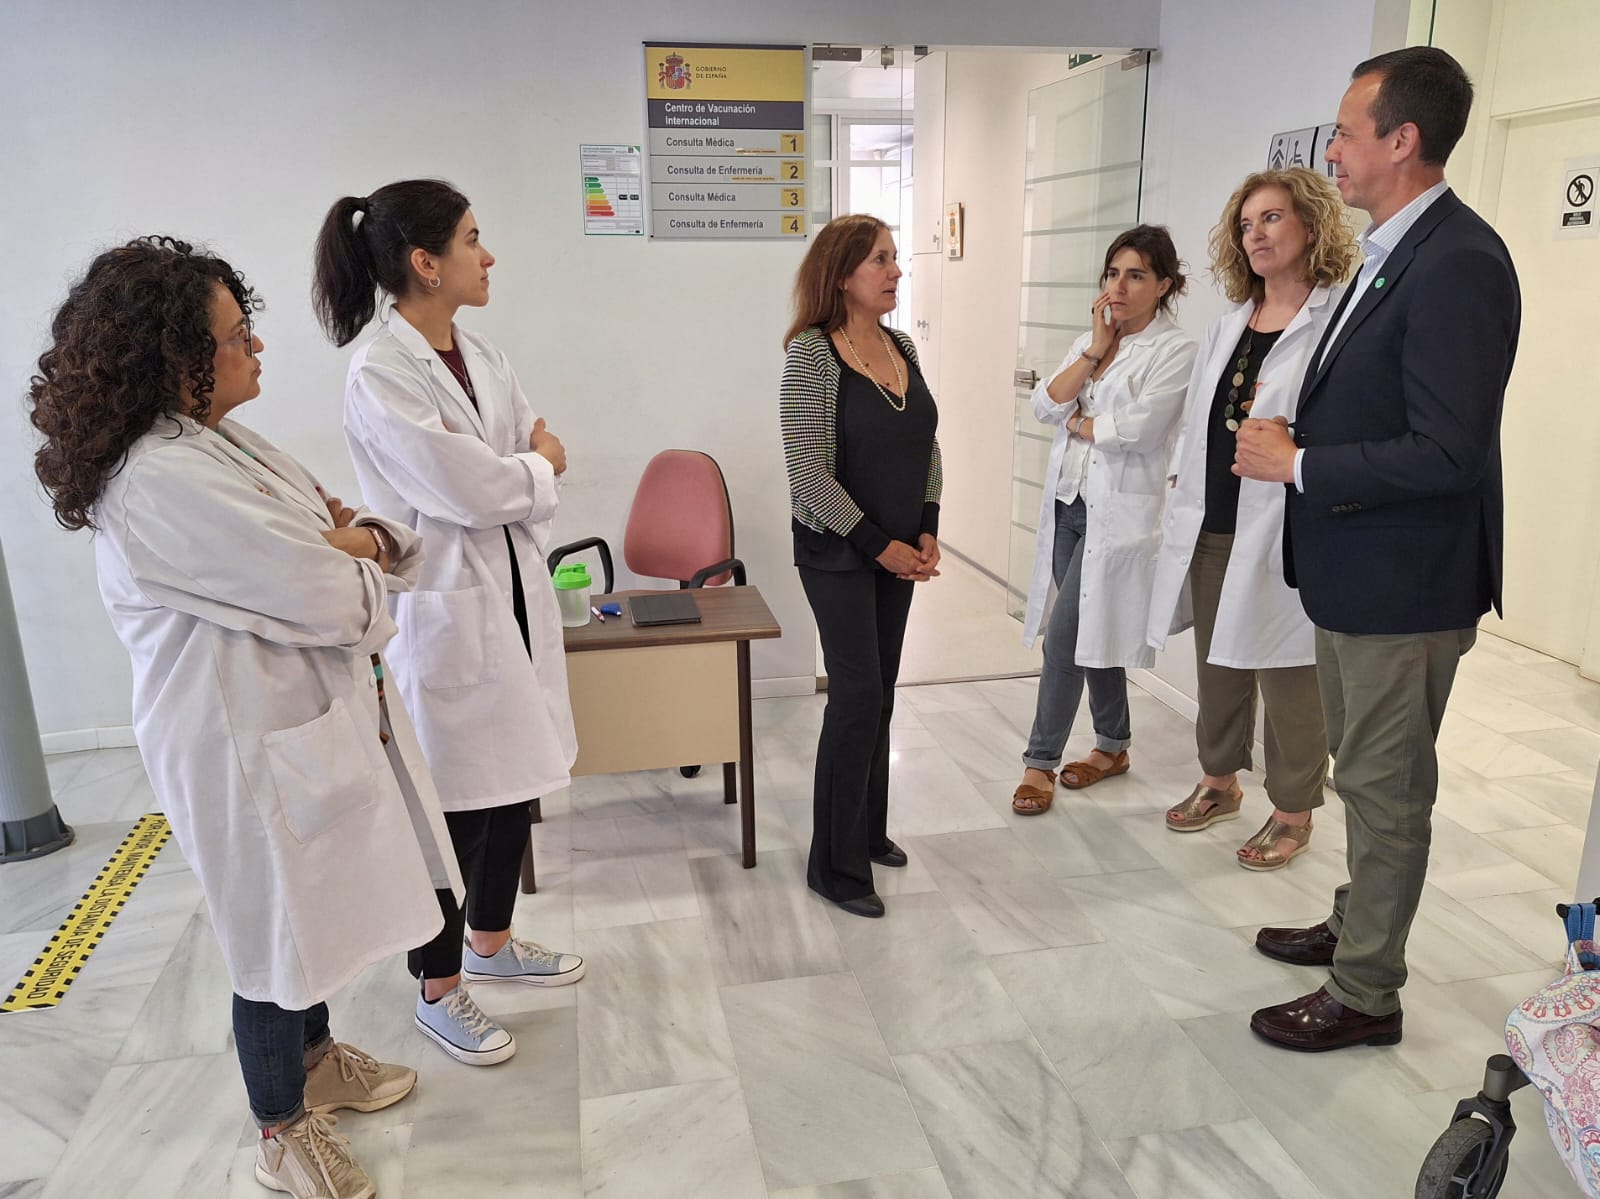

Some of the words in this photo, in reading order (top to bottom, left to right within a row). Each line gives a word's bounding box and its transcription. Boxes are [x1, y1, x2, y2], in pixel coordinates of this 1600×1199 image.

[664, 103, 694, 113] Centro
[695, 104, 706, 113] de
[708, 104, 756, 114] Vacunación
[665, 116, 720, 126] Internacional
[666, 137, 704, 147] Consulta
[706, 138, 735, 147] Médica
[790, 138, 796, 152] 1
[667, 166, 704, 175] Consulta
[706, 166, 716, 175] de
[718, 165, 762, 175] Enfermería
[790, 165, 798, 179] 2
[668, 192, 705, 202] Consulta
[707, 192, 736, 202] Médica
[790, 192, 798, 206] 3
[670, 219, 706, 229] Consulta
[708, 220, 718, 229] de
[720, 219, 764, 229] Enfermería
[790, 219, 799, 232] 4
[105, 852, 144, 888] MANTENGA
[100, 888, 120, 898] LA
[72, 898, 110, 937] DISTANCIA
[62, 938, 82, 950] DE
[27, 950, 72, 999] SEGURIDAD
